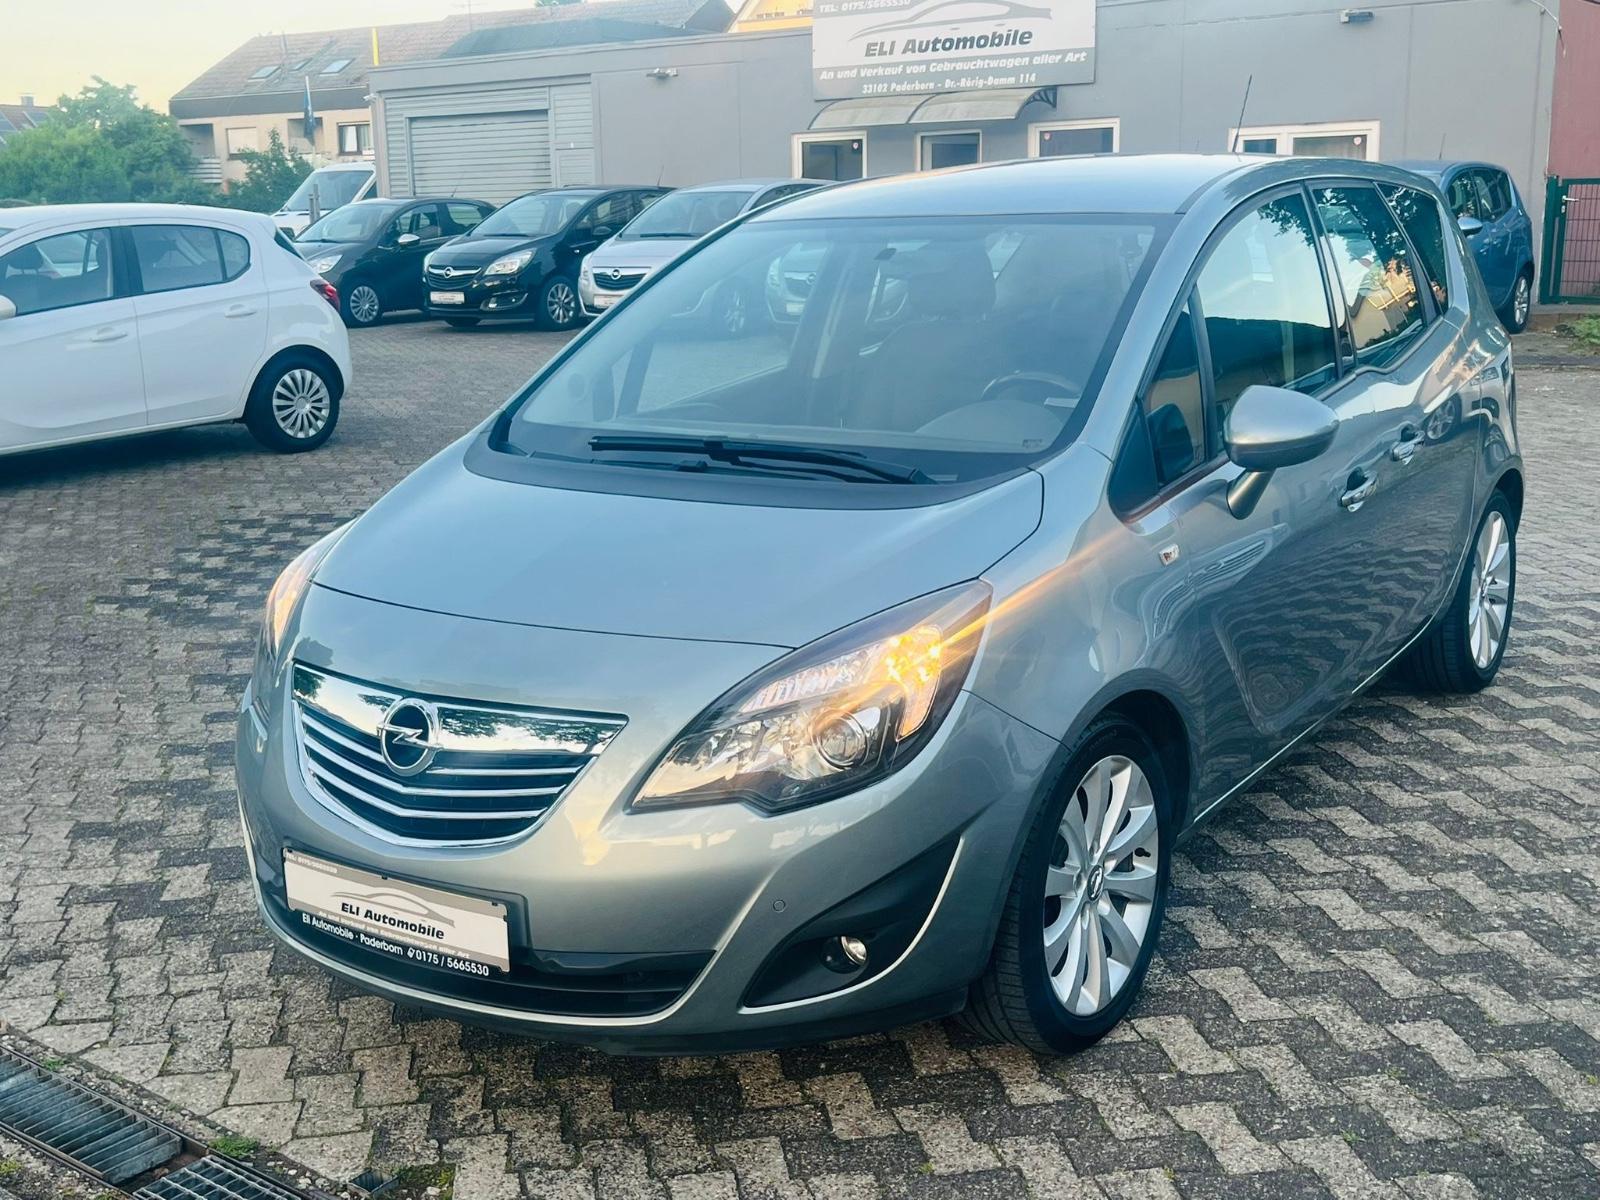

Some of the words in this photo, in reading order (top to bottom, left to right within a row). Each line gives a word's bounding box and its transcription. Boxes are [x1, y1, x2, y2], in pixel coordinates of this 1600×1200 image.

[864, 41, 896, 57] ELI
[901, 29, 1033, 54] Automobile
[820, 70, 834, 80] An
[837, 68, 857, 79] und
[860, 65, 903, 77] Verkauf
[906, 64, 926, 74] von
[929, 57, 1029, 72] Gebrauchtwagen
[1033, 54, 1062, 65] aller
[1065, 51, 1087, 62] Art
[862, 83, 887, 93] 33102
[890, 81, 934, 92] Paderborn
[1020, 73, 1036, 83] 114
[341, 902, 360, 916] ELI
[364, 909, 444, 940] Automobile
[312, 916, 354, 940] Automobile
[360, 933, 403, 955] Paderborn
[415, 949, 439, 965] 0175
[447, 957, 489, 977] 5665530
